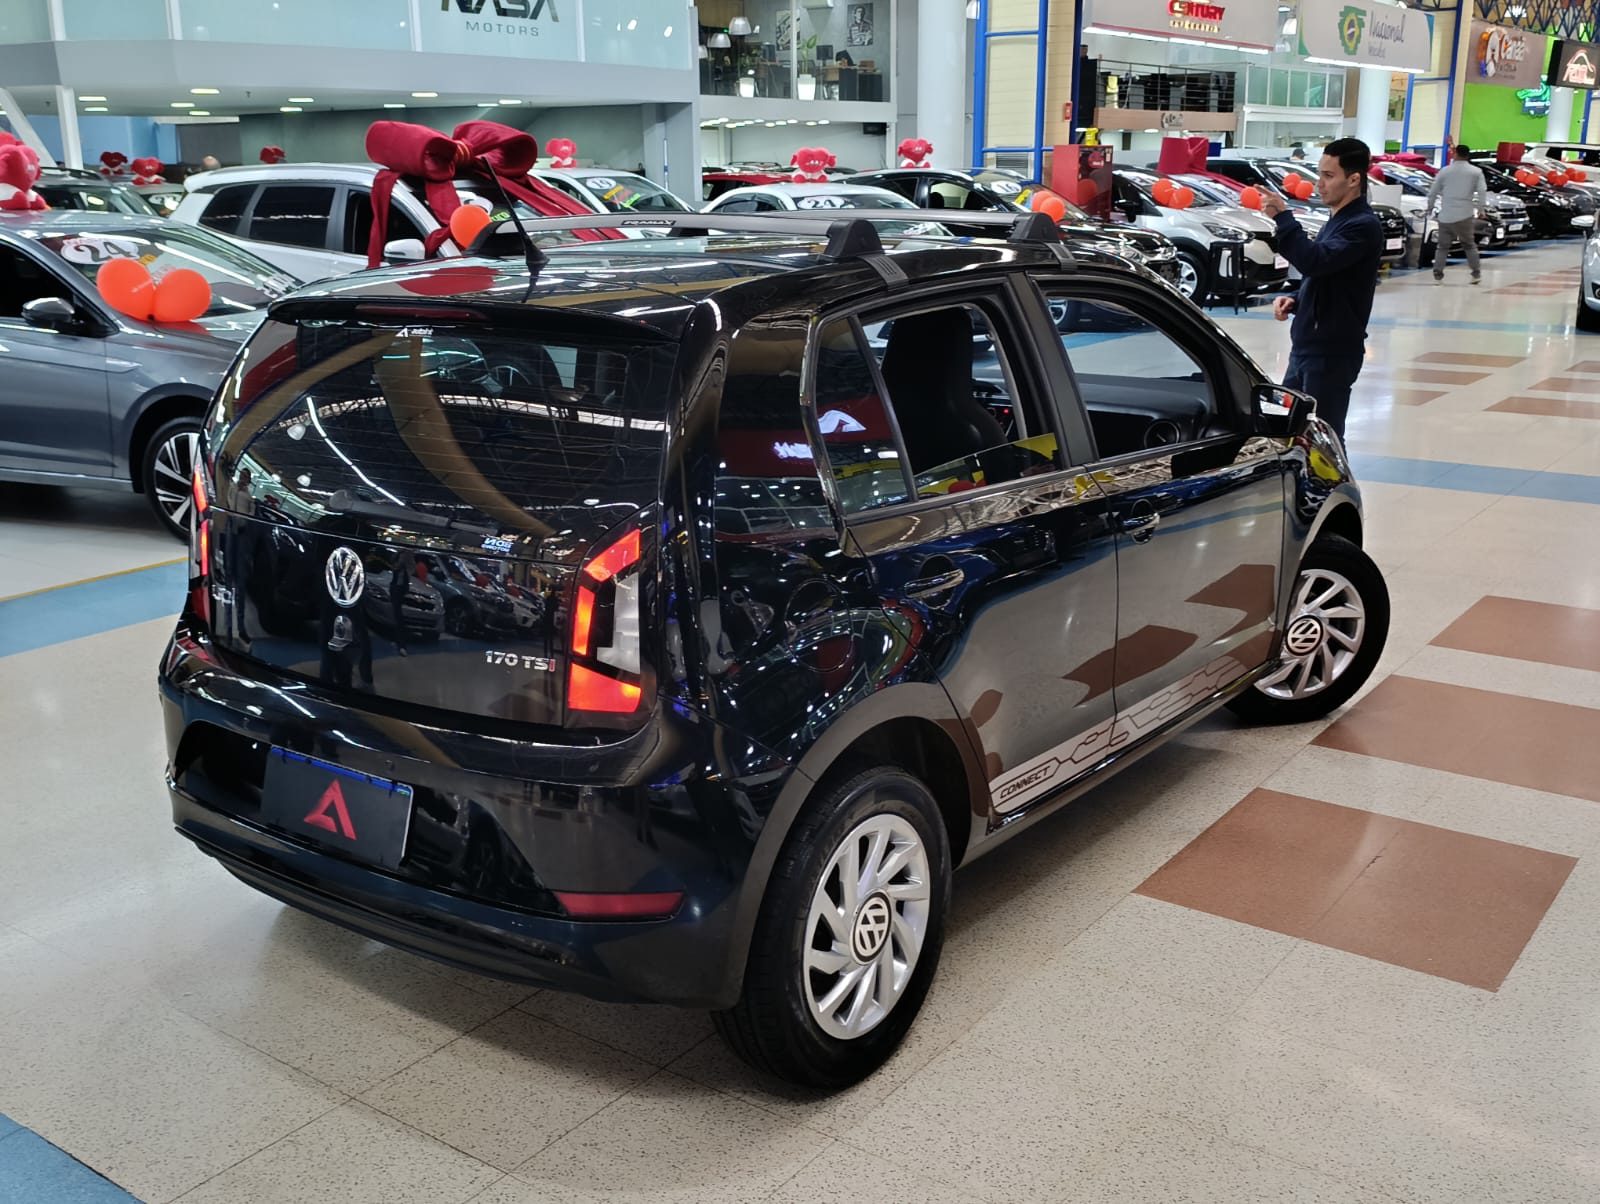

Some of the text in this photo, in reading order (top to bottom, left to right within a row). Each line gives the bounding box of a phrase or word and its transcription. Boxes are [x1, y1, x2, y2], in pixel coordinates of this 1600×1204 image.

[465, 20, 540, 37] MOTORS
[485, 650, 556, 672] 170 TSI
[1000, 765, 1051, 799] CONNECT
